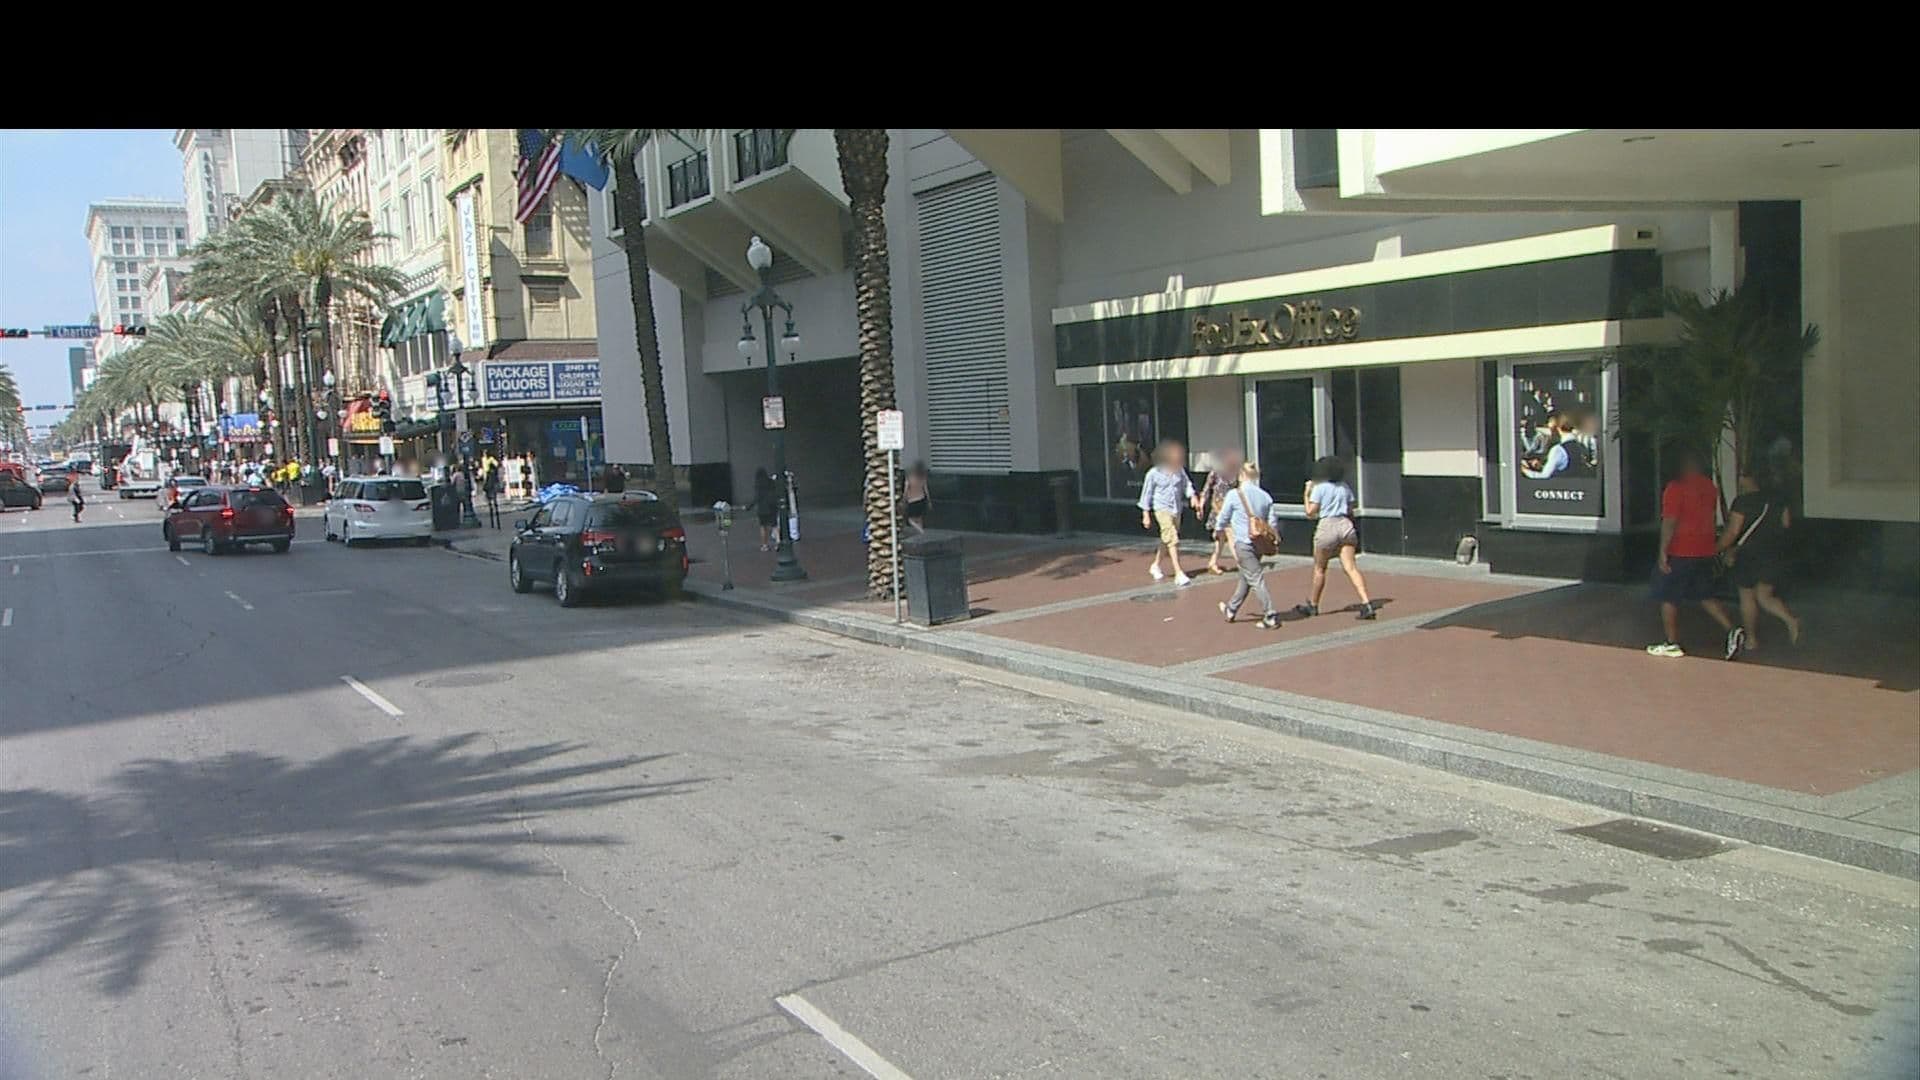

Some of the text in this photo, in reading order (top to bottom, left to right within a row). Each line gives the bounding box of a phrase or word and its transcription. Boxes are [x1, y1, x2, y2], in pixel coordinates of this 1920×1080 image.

[463, 204, 474, 257] JAZZ
[467, 267, 479, 320] CITY
[487, 366, 547, 379] PACKAGE
[490, 378, 547, 391] LIQUORS
[1534, 490, 1585, 500] CONNECT
